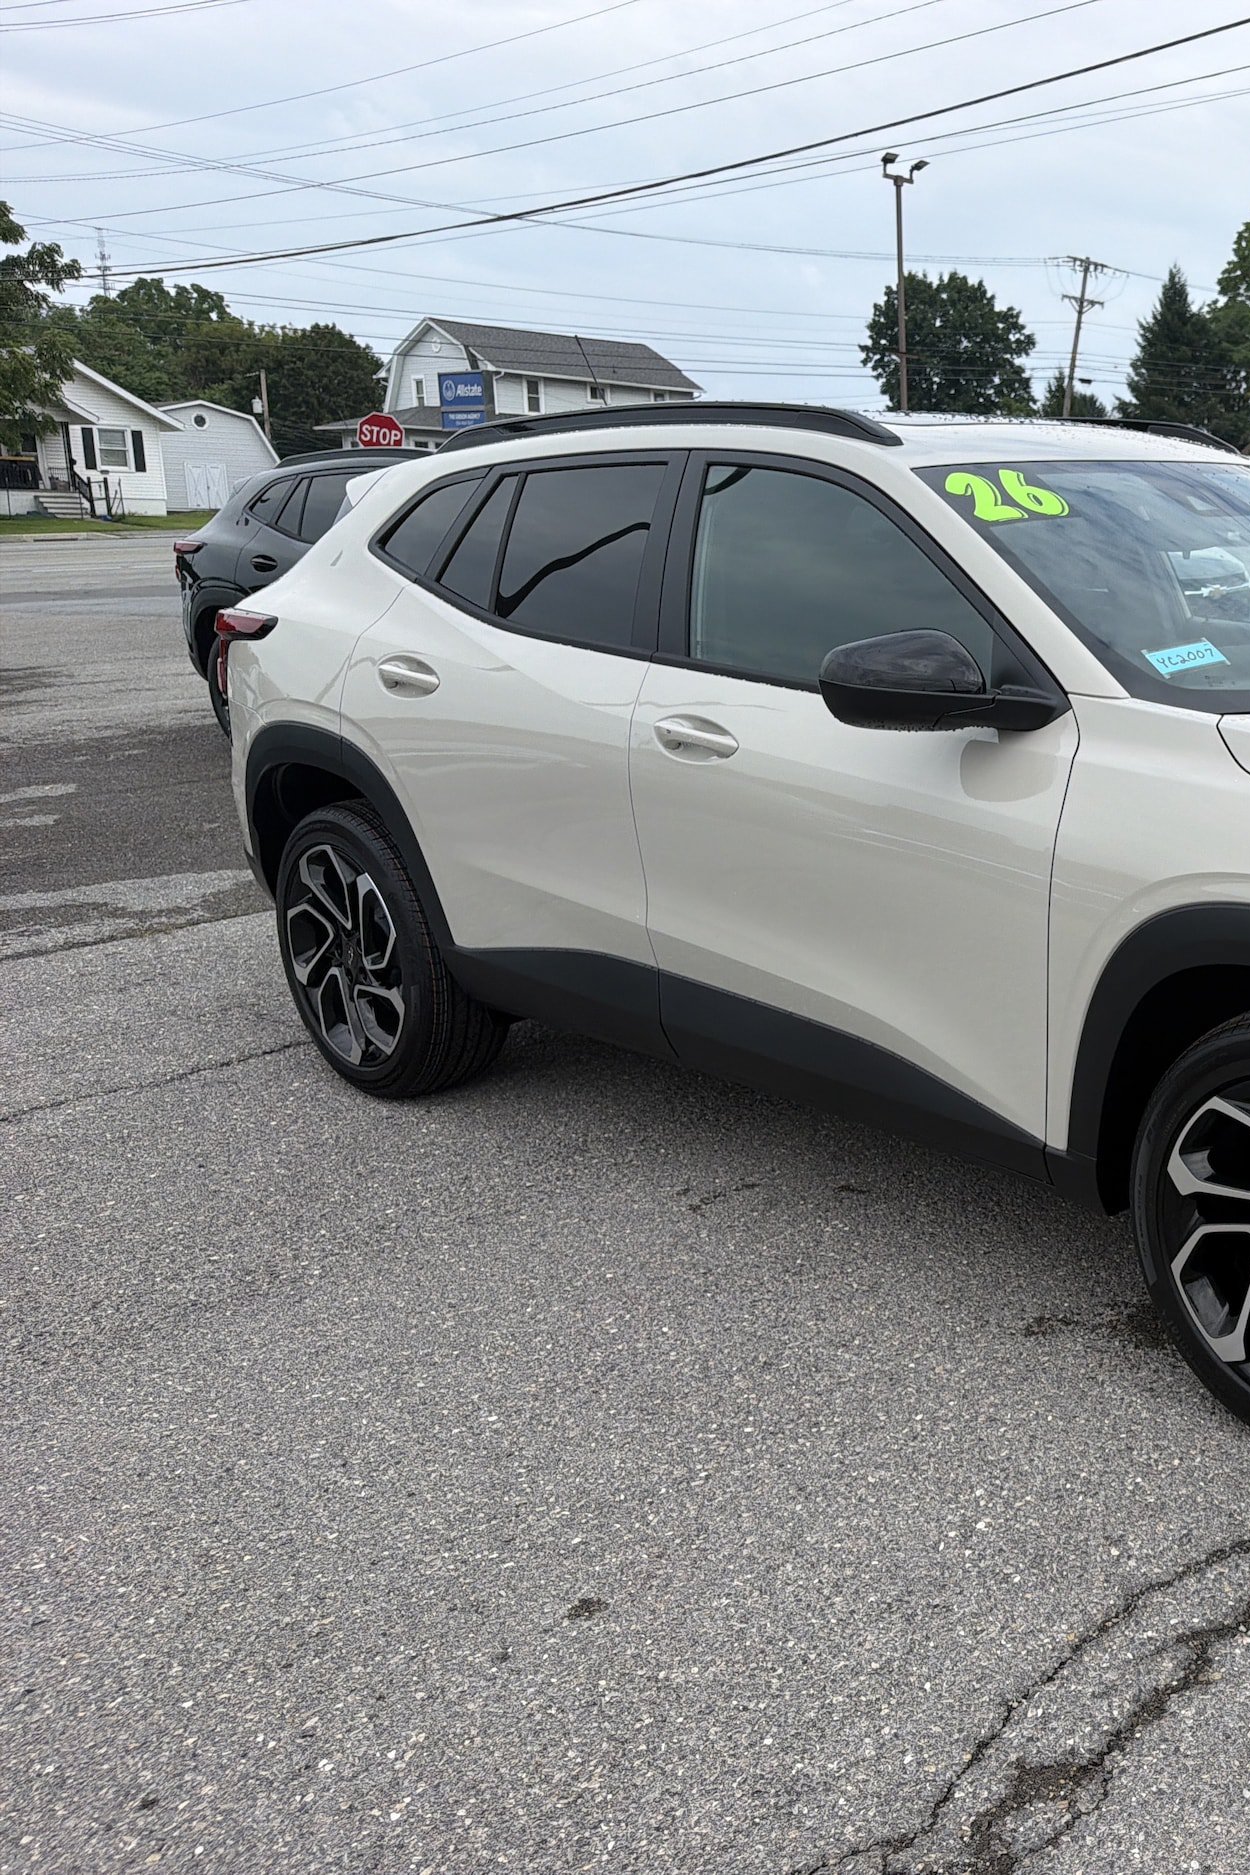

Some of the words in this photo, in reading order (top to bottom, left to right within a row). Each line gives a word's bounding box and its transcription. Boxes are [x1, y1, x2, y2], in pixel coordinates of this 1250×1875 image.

[456, 384, 482, 397] Allstate
[361, 424, 401, 446] STOP
[945, 469, 1069, 522] 26
[1157, 648, 1214, 668] YC2007
